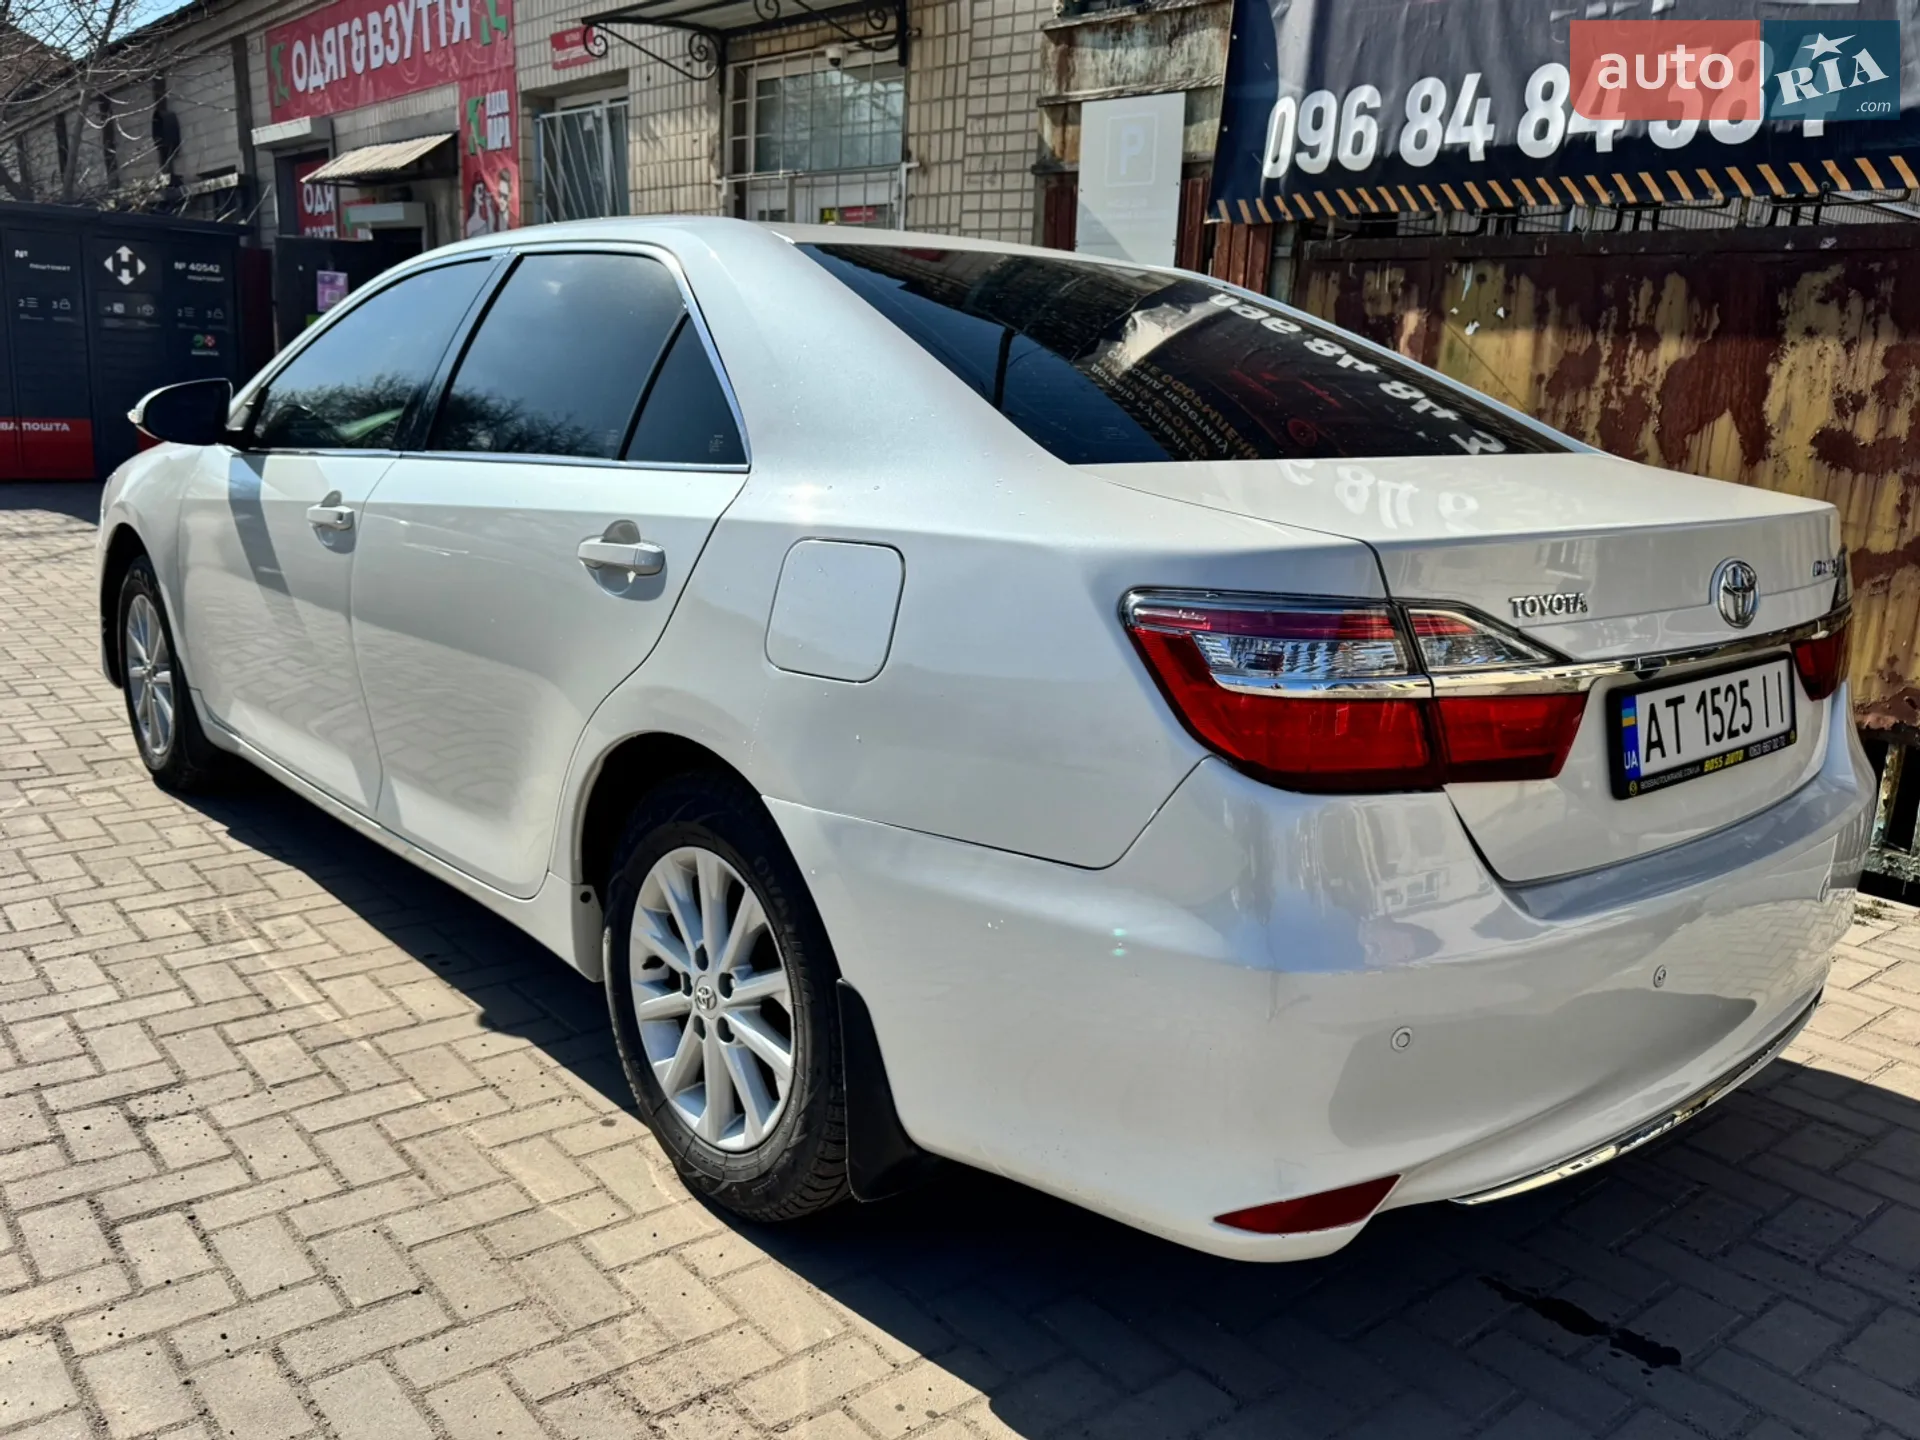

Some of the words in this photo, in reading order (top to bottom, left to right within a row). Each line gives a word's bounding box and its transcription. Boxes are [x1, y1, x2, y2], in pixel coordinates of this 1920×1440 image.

[1262, 84, 1382, 179] 096
[1399, 72, 1495, 167] 84
[1516, 58, 1626, 159] 84
[188, 263, 221, 274] 40542
[22, 422, 70, 431] ПОШТА
[1508, 592, 1588, 618] TOYOTA
[1645, 695, 1686, 763] AT
[1696, 679, 1753, 746] 1525
[1623, 751, 1639, 770] UA
[1703, 756, 1723, 773] BOSS
